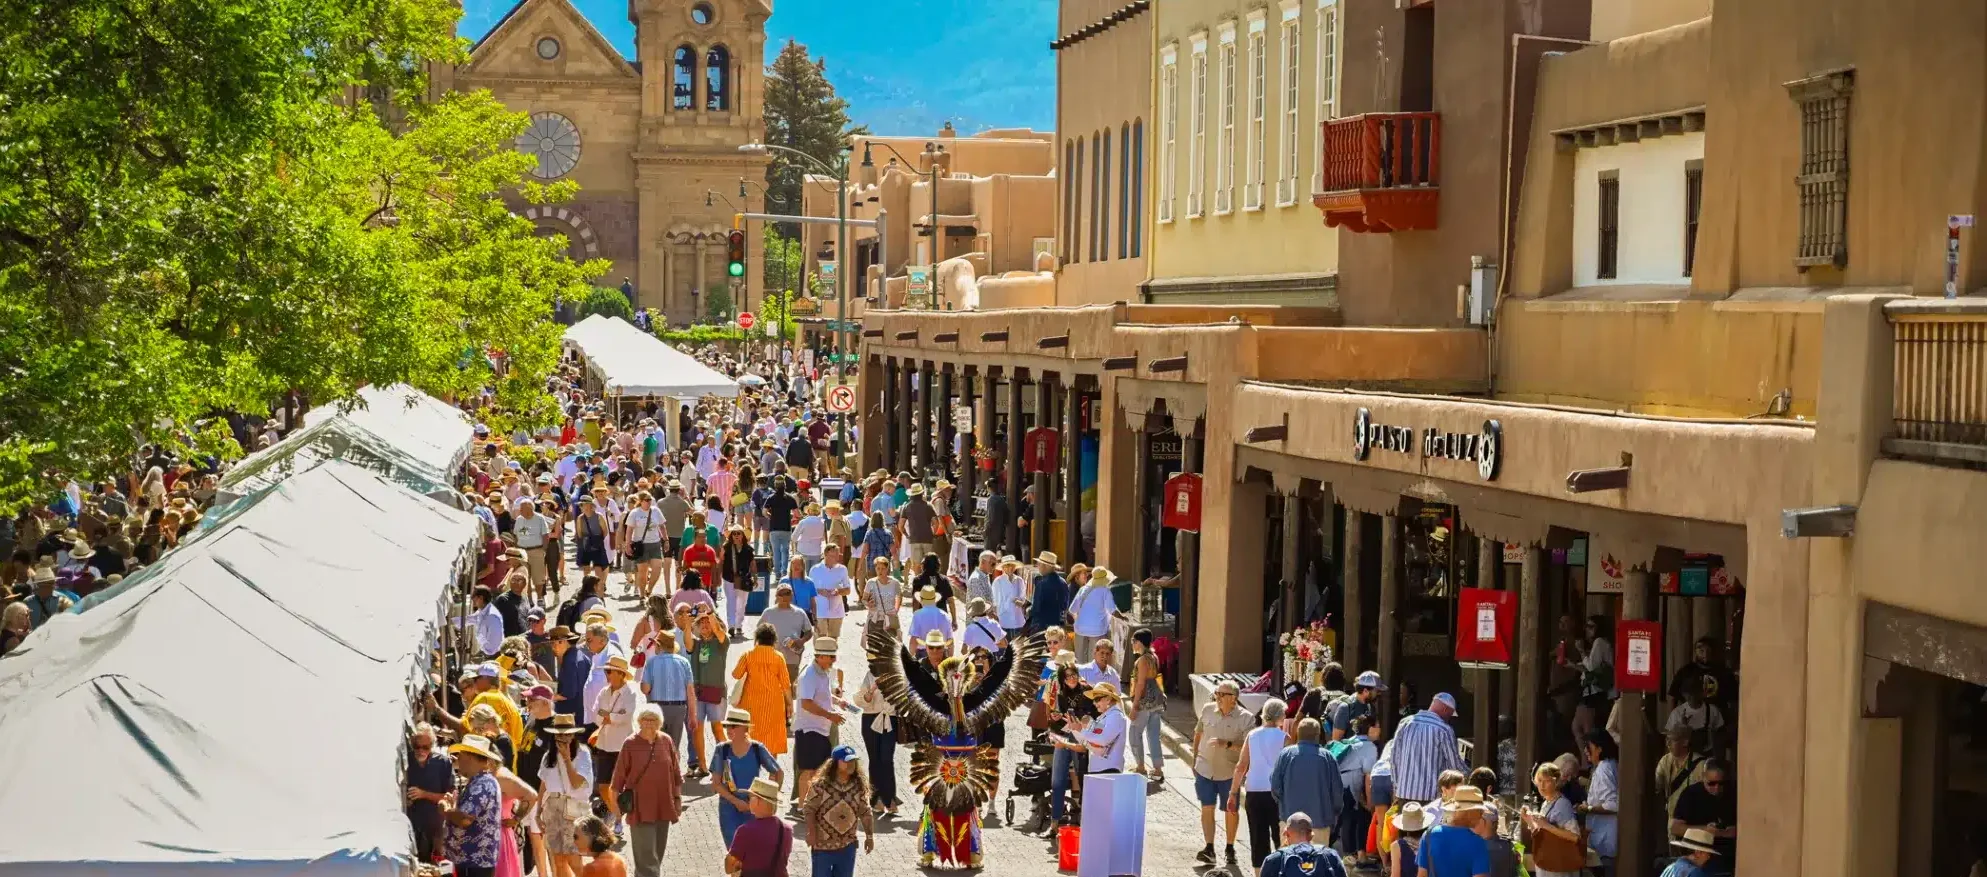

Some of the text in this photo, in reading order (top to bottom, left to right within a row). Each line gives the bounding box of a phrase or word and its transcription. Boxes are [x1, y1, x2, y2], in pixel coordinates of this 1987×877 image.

[1369, 423, 1411, 453] PASO
[1152, 442, 1182, 453] ERL
[1602, 581, 1622, 590] SHO
